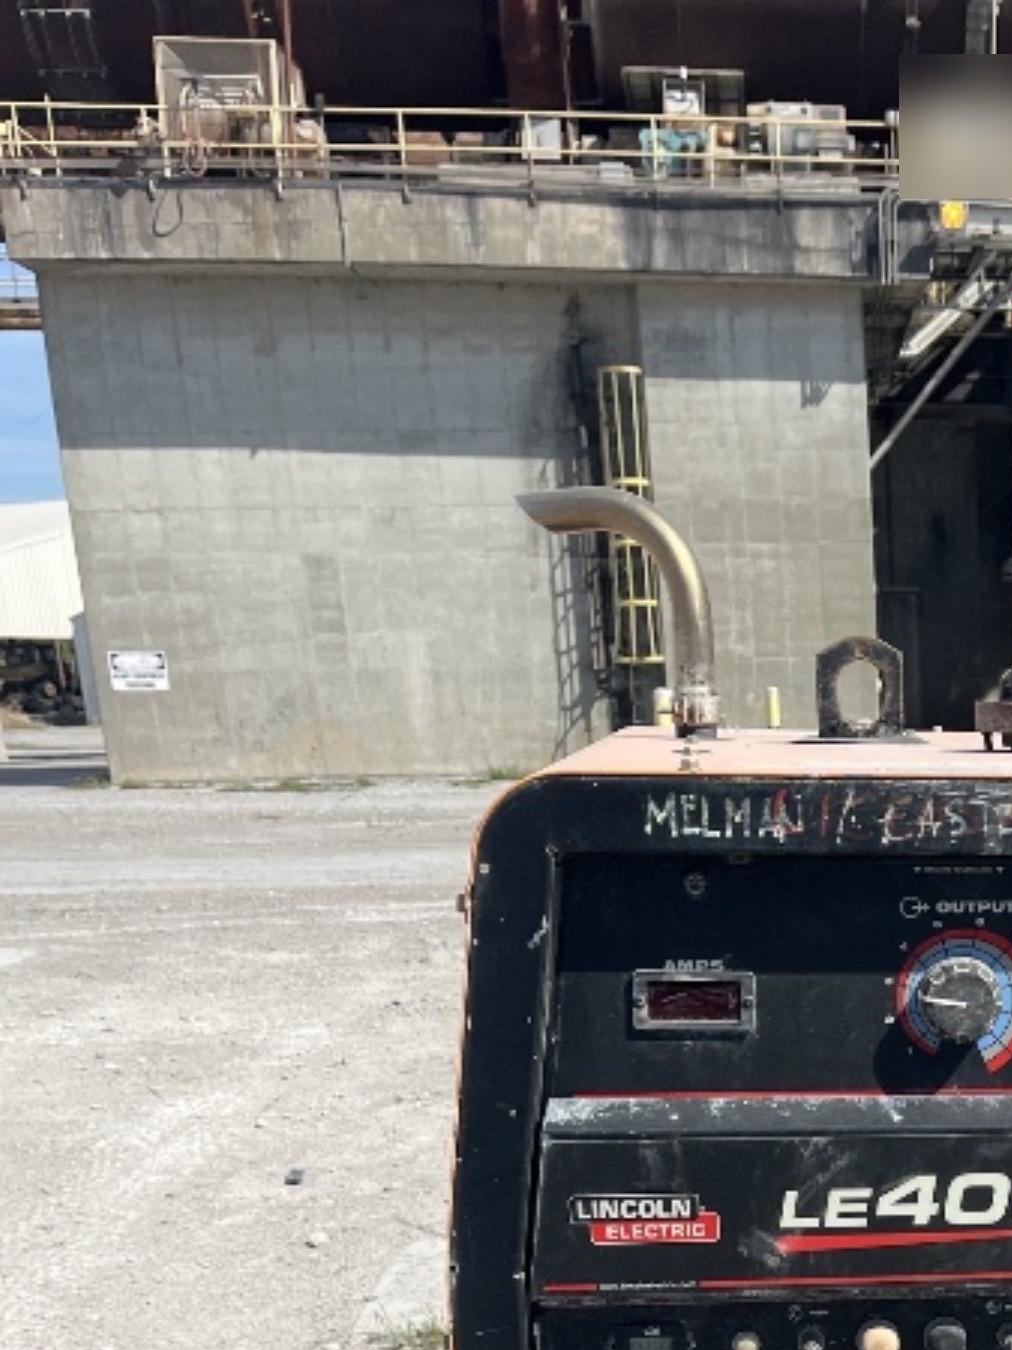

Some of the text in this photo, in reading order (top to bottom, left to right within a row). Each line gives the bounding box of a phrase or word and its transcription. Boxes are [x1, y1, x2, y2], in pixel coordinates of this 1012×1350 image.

[663, 959, 727, 972] AMPS
[575, 1199, 692, 1220] LINCOLN
[604, 1222, 708, 1241] ELECTRIC
